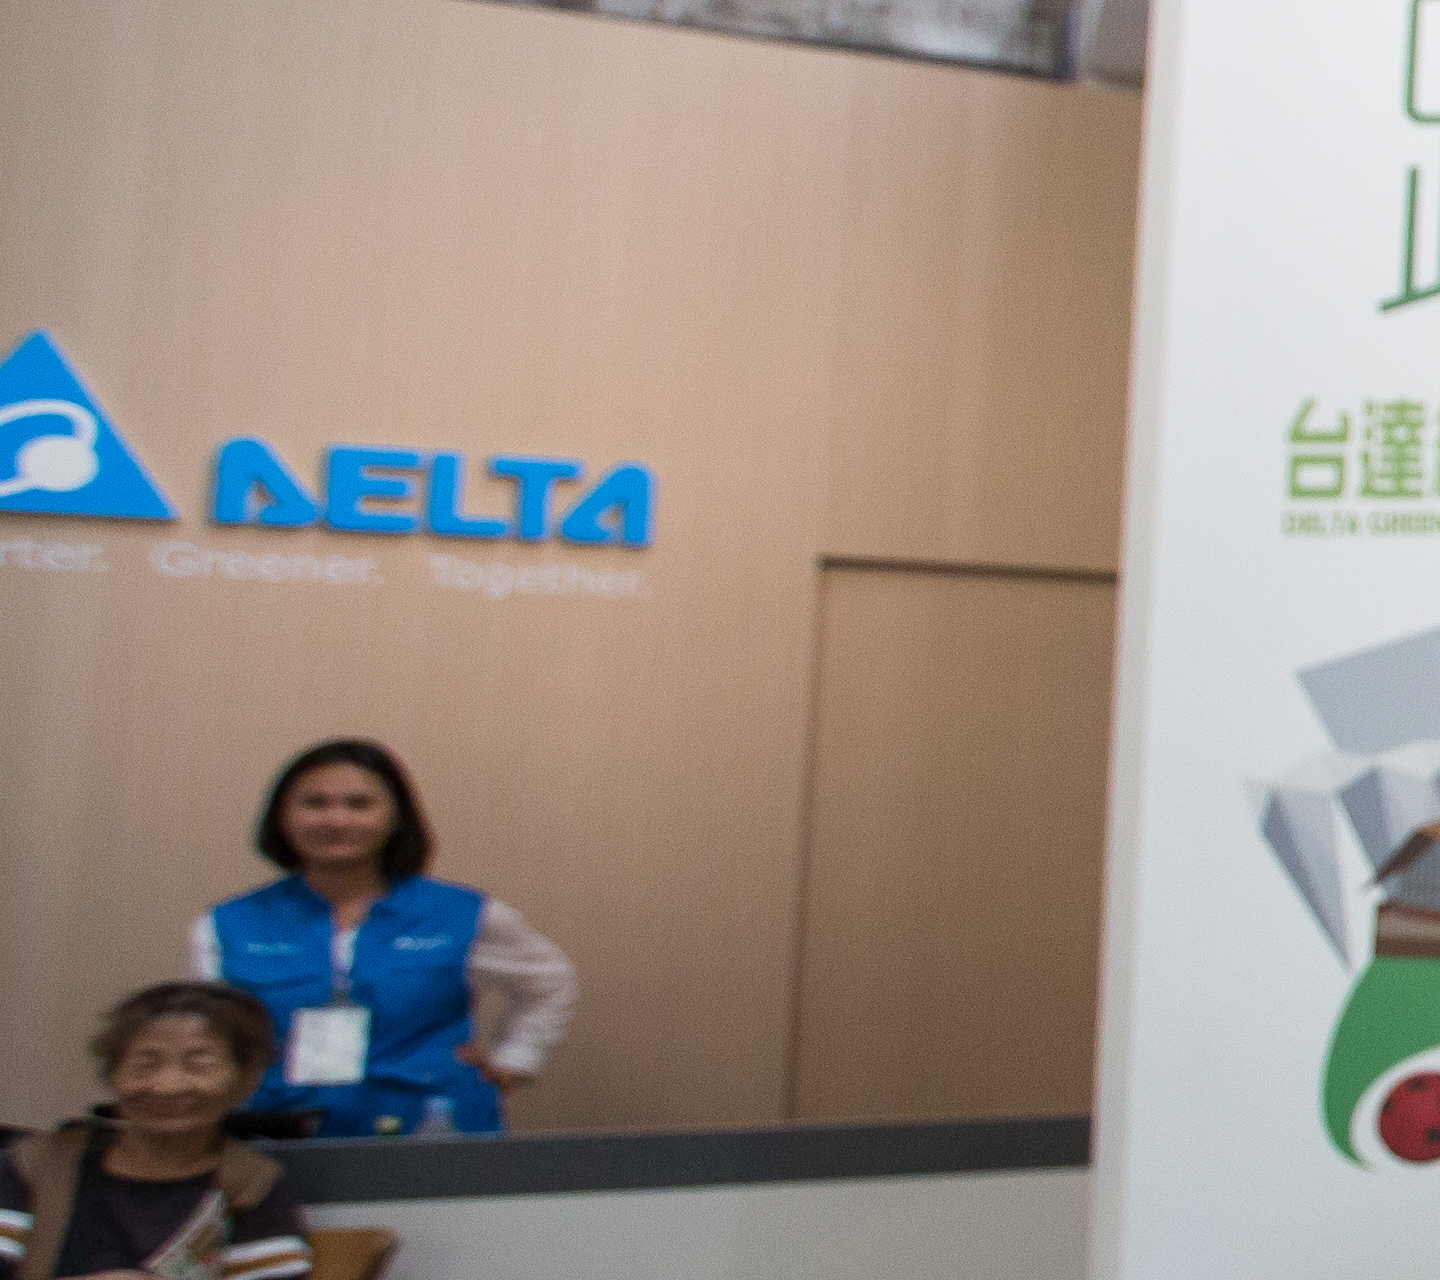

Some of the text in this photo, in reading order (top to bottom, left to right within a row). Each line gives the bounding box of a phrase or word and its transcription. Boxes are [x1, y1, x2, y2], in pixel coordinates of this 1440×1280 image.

[209, 435, 656, 547] DELTA
[1281, 510, 1358, 536] DELTA
[150, 540, 385, 588] Greener.
[426, 550, 653, 601] Together.
